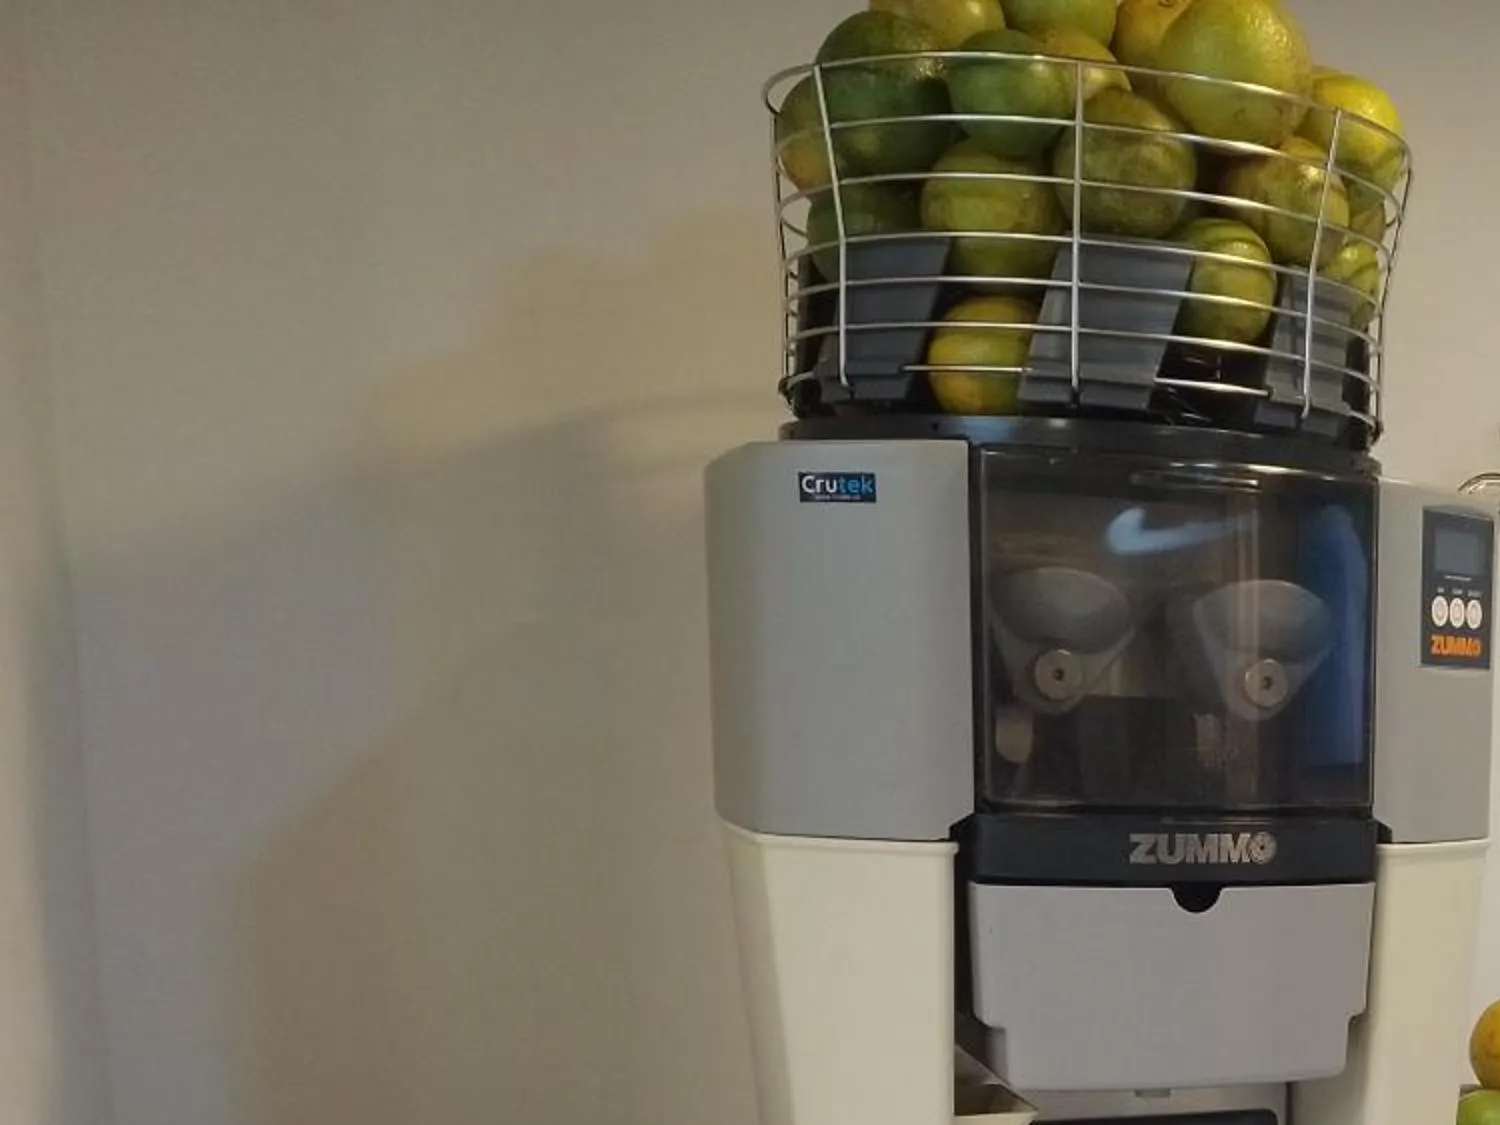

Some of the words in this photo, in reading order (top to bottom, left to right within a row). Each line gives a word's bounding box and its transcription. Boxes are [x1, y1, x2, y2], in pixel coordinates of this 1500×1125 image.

[801, 475, 873, 493] Crutek
[1431, 634, 1481, 656] ZUMMO
[1129, 832, 1277, 865] ZUMMO
